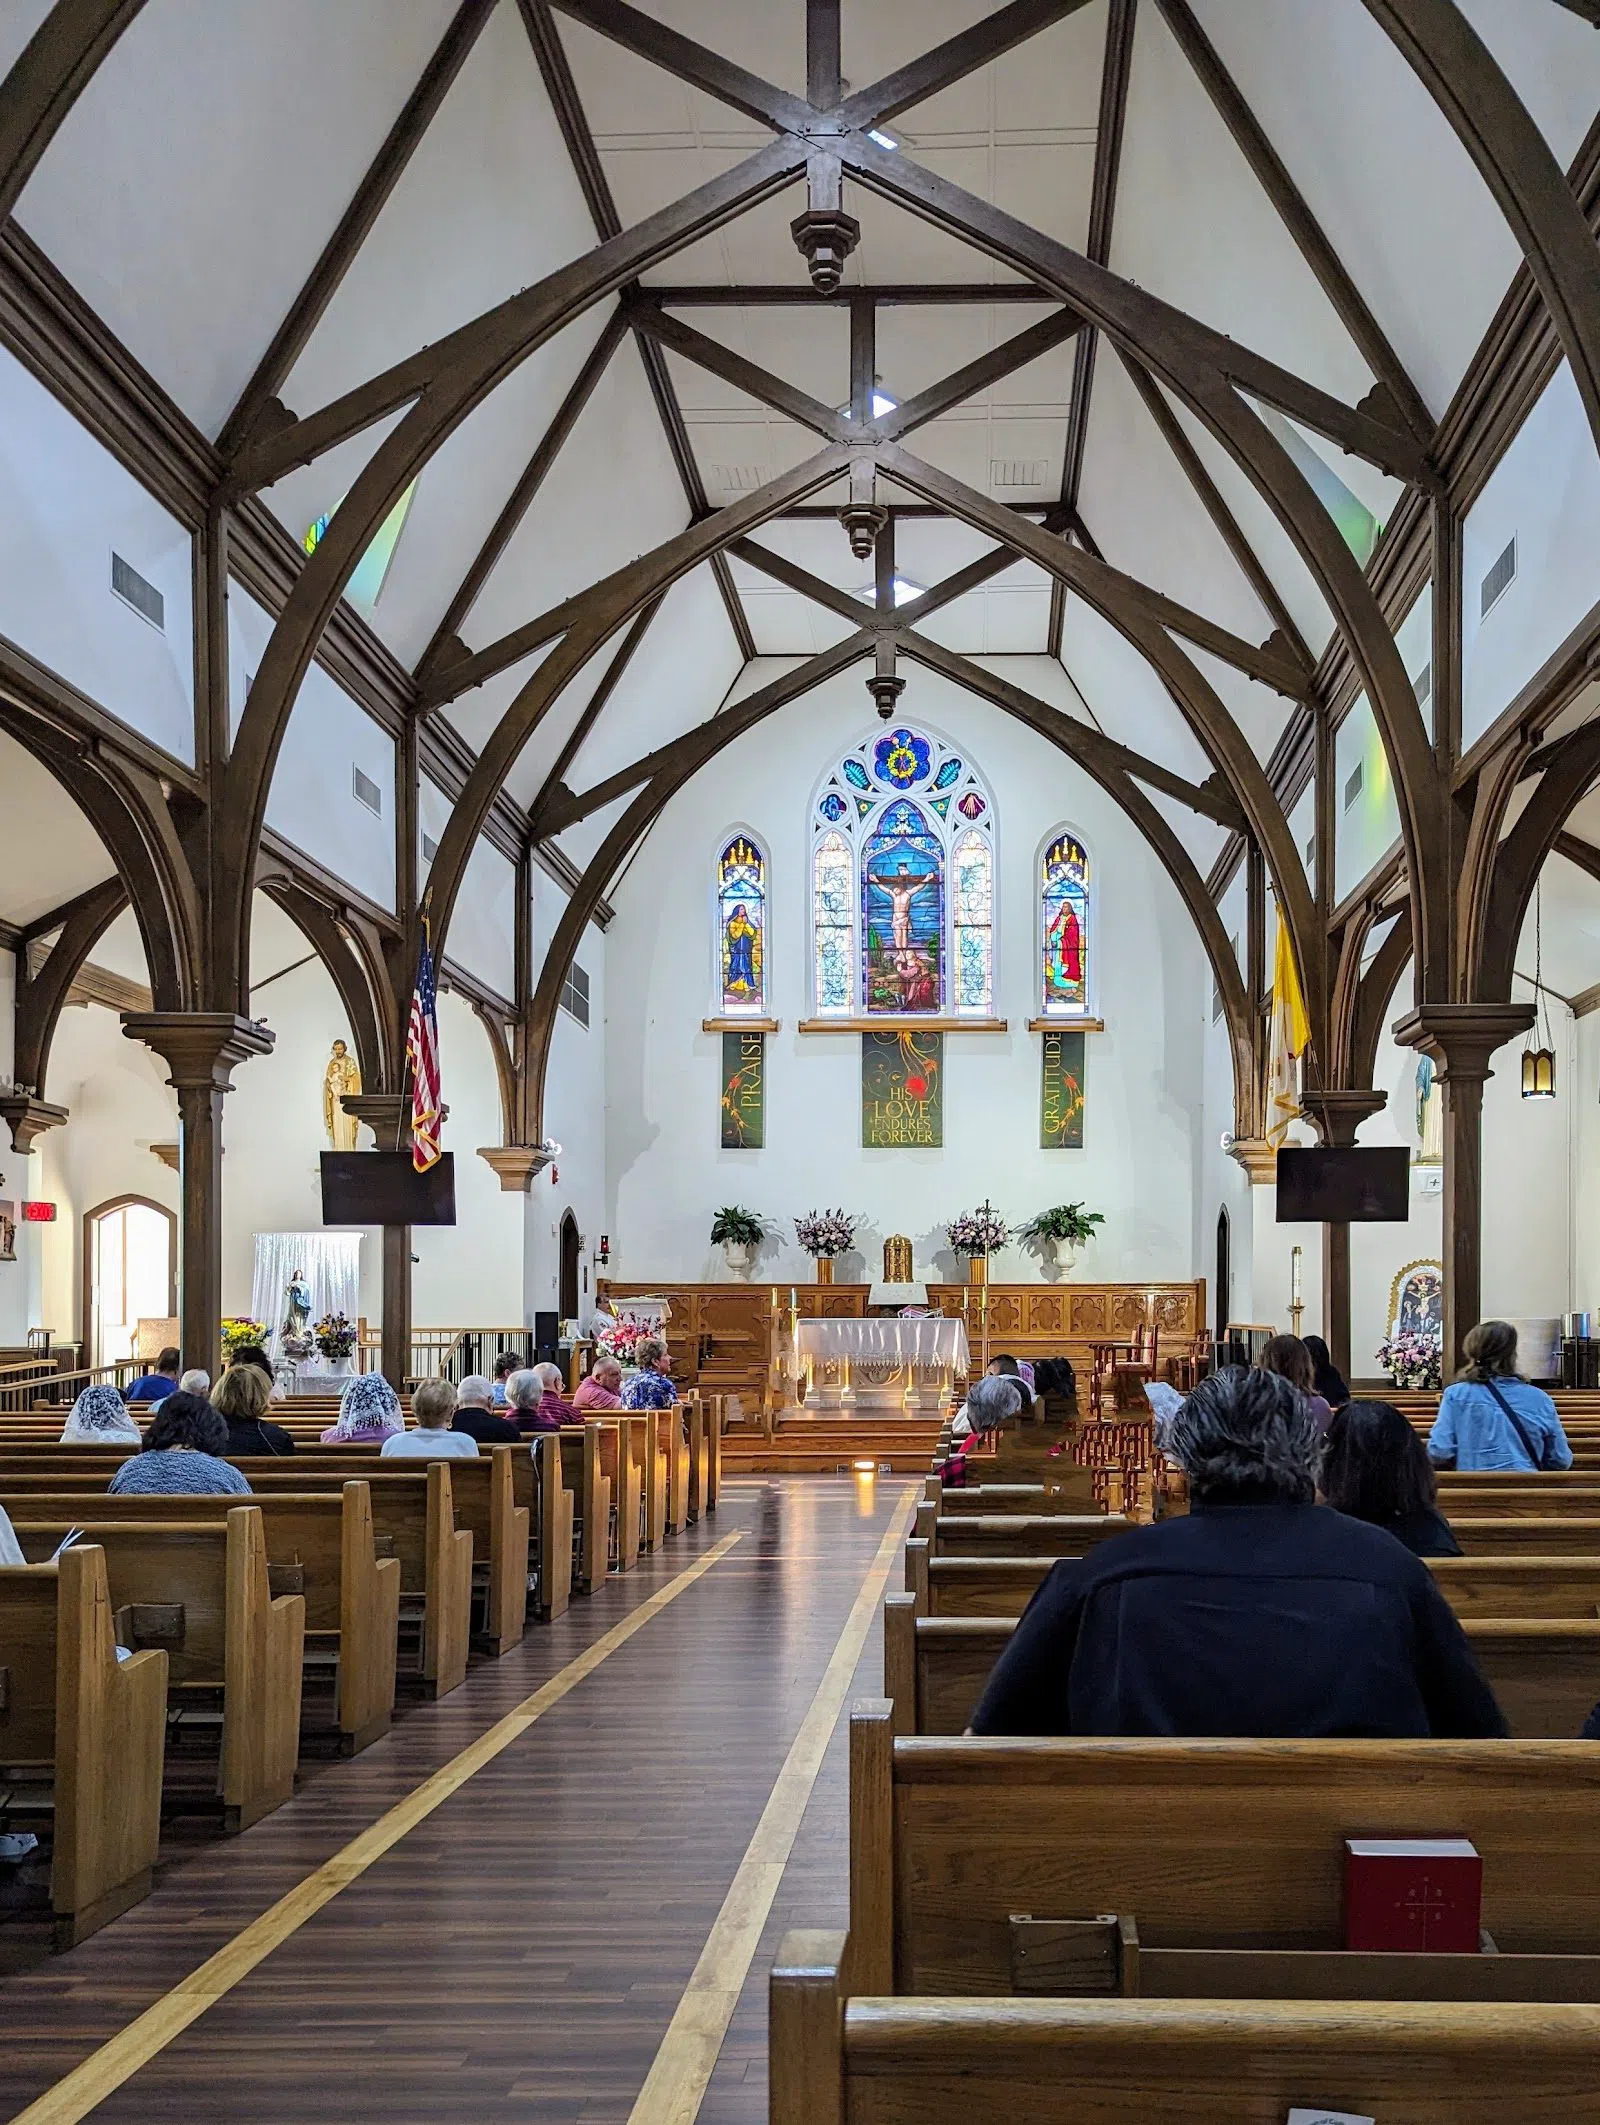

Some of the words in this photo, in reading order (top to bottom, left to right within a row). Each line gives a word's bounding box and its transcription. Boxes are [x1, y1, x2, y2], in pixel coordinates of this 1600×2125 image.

[741, 1033, 762, 1107] PRAISE
[1043, 1033, 1062, 1133] GRATITUDE
[890, 1087, 913, 1101] HIS
[875, 1100, 931, 1119] LOVE
[874, 1118, 931, 1130] ENDURES
[871, 1129, 934, 1143] FOREVER
